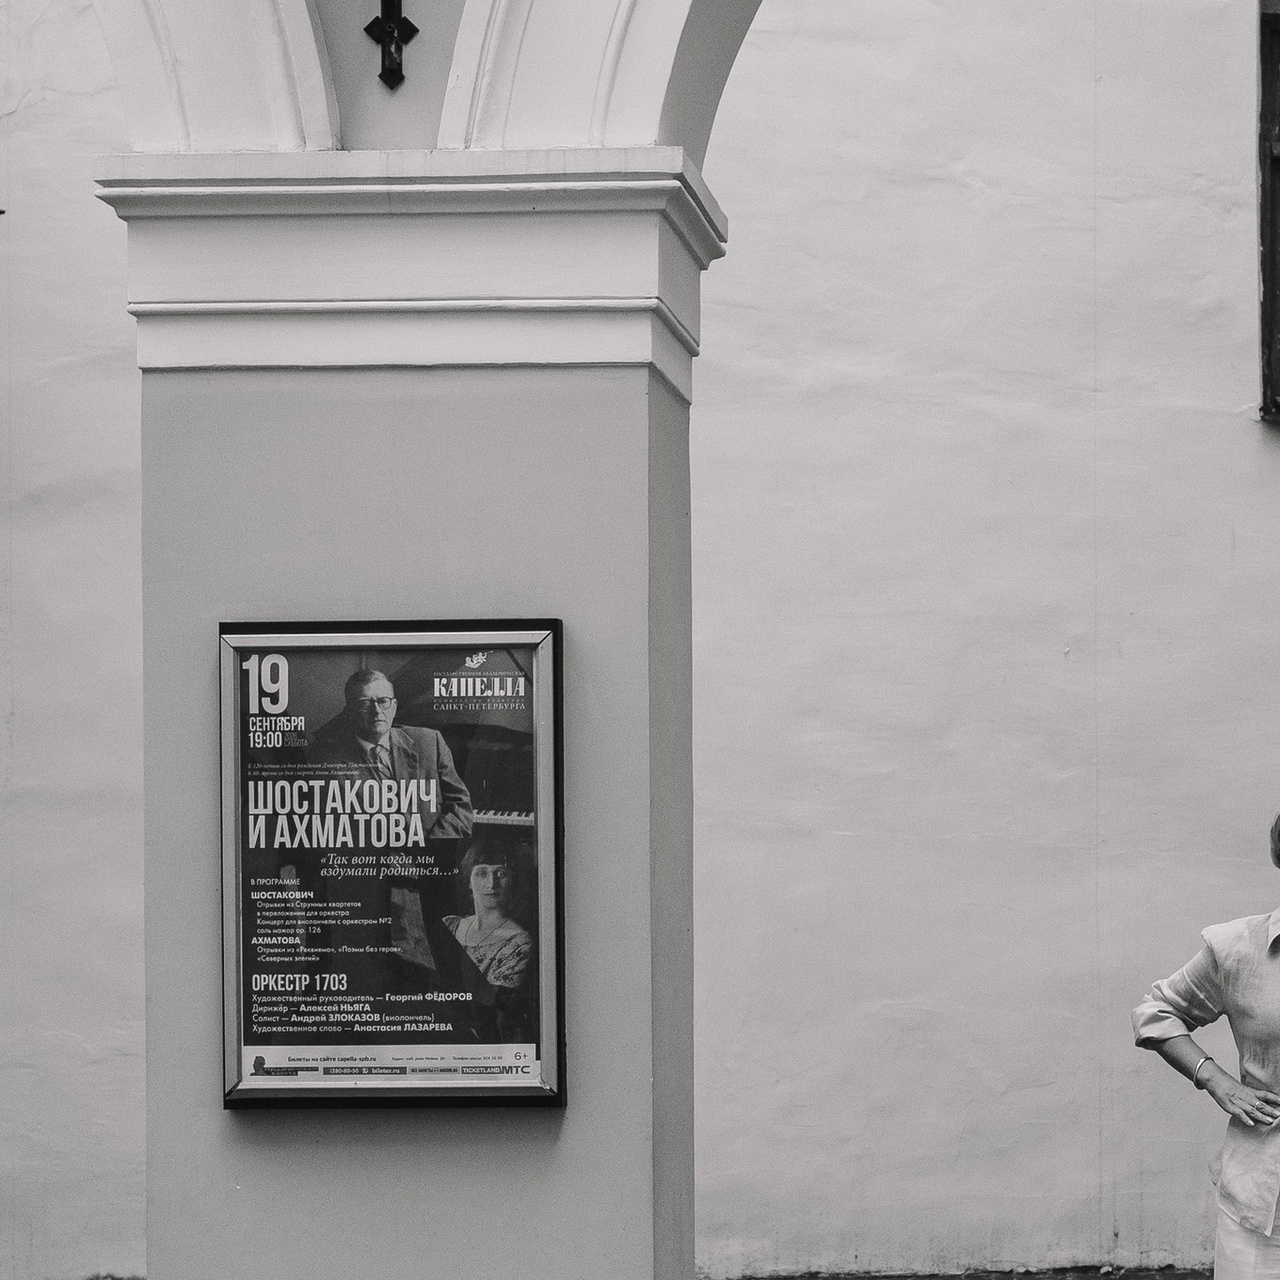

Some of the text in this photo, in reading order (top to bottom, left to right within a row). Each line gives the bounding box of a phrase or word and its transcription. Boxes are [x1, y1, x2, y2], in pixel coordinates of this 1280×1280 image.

[242, 653, 289, 715] 19
[433, 677, 525, 697] КАПЕЛЛА
[433, 703, 525, 711] САНКТ-ПЕТЕРБУРГА
[249, 716, 305, 732] СЕНТЯБРЯ
[248, 731, 283, 748] 19:00
[248, 779, 437, 814] ШОСТАКОВИЧ
[248, 813, 426, 848] И АХМАТОВА
[321, 853, 435, 866] «Так вот когда мы
[320, 865, 379, 878] вздумали
[250, 891, 314, 899] ШОСТАКОВИЧ
[251, 936, 301, 944] АХМАТОВА
[252, 974, 348, 991] ОРКЕСТР 1703
[252, 991, 473, 1003] Художественный руководитель Георгий ФЁДОРОВ
[252, 1004, 371, 1013] Дирижёр Алексей НЬЯГА
[252, 1013, 435, 1023] Солист Андрей ЗЛОКАЗОВ (виолончель)
[252, 1024, 317, 1033] Художественное
[353, 1024, 402, 1032] Анастасия
[403, 1023, 453, 1032] ЛАЗАРЕВА
[514, 1051, 528, 1061] 6+
